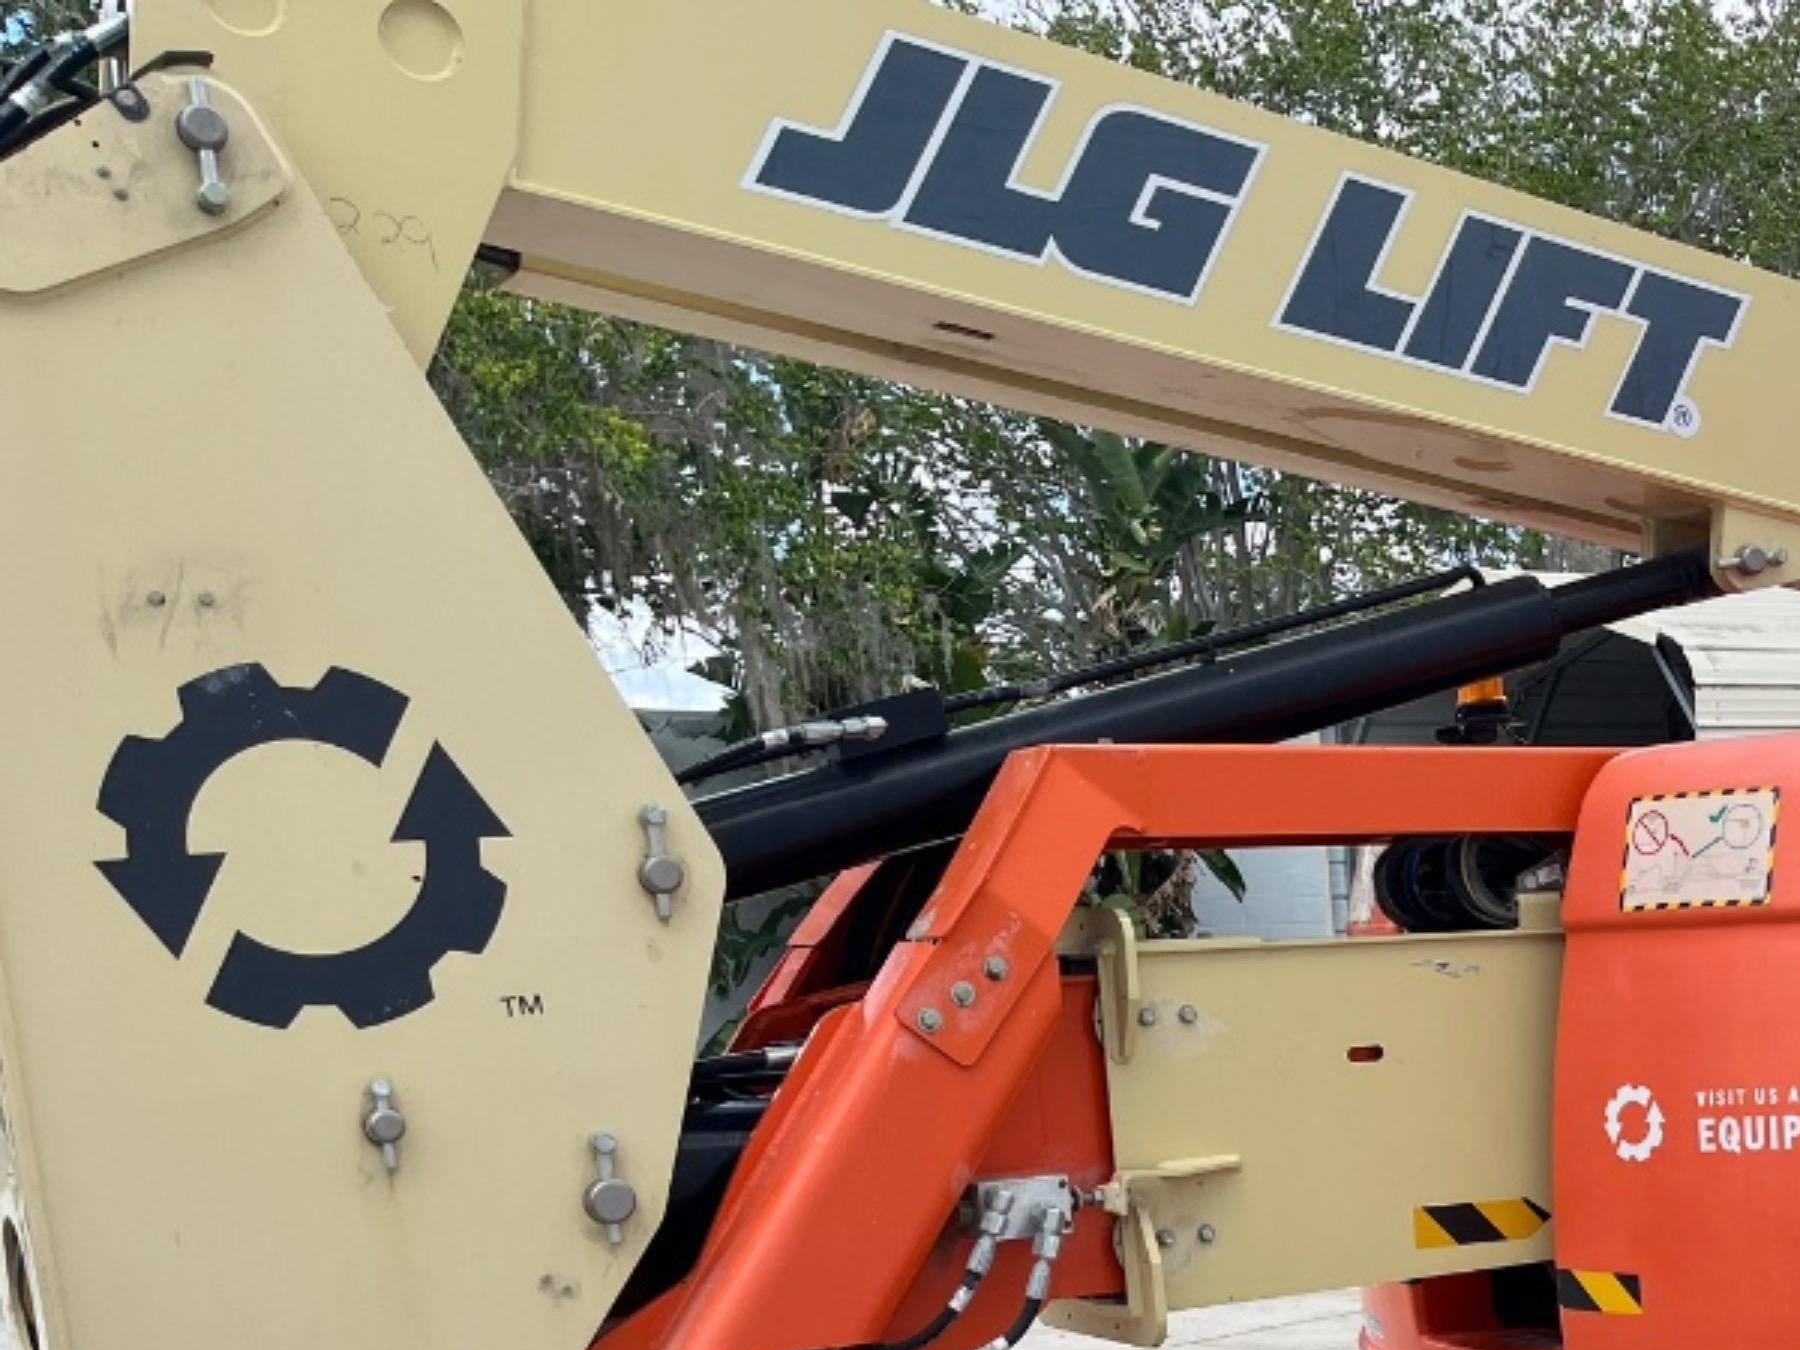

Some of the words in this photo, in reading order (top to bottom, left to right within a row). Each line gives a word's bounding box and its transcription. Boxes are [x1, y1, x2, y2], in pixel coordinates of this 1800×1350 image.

[740, 27, 1270, 308] JLG
[1695, 1087, 1746, 1108] VISIT
[1753, 1087, 1779, 1105] US
